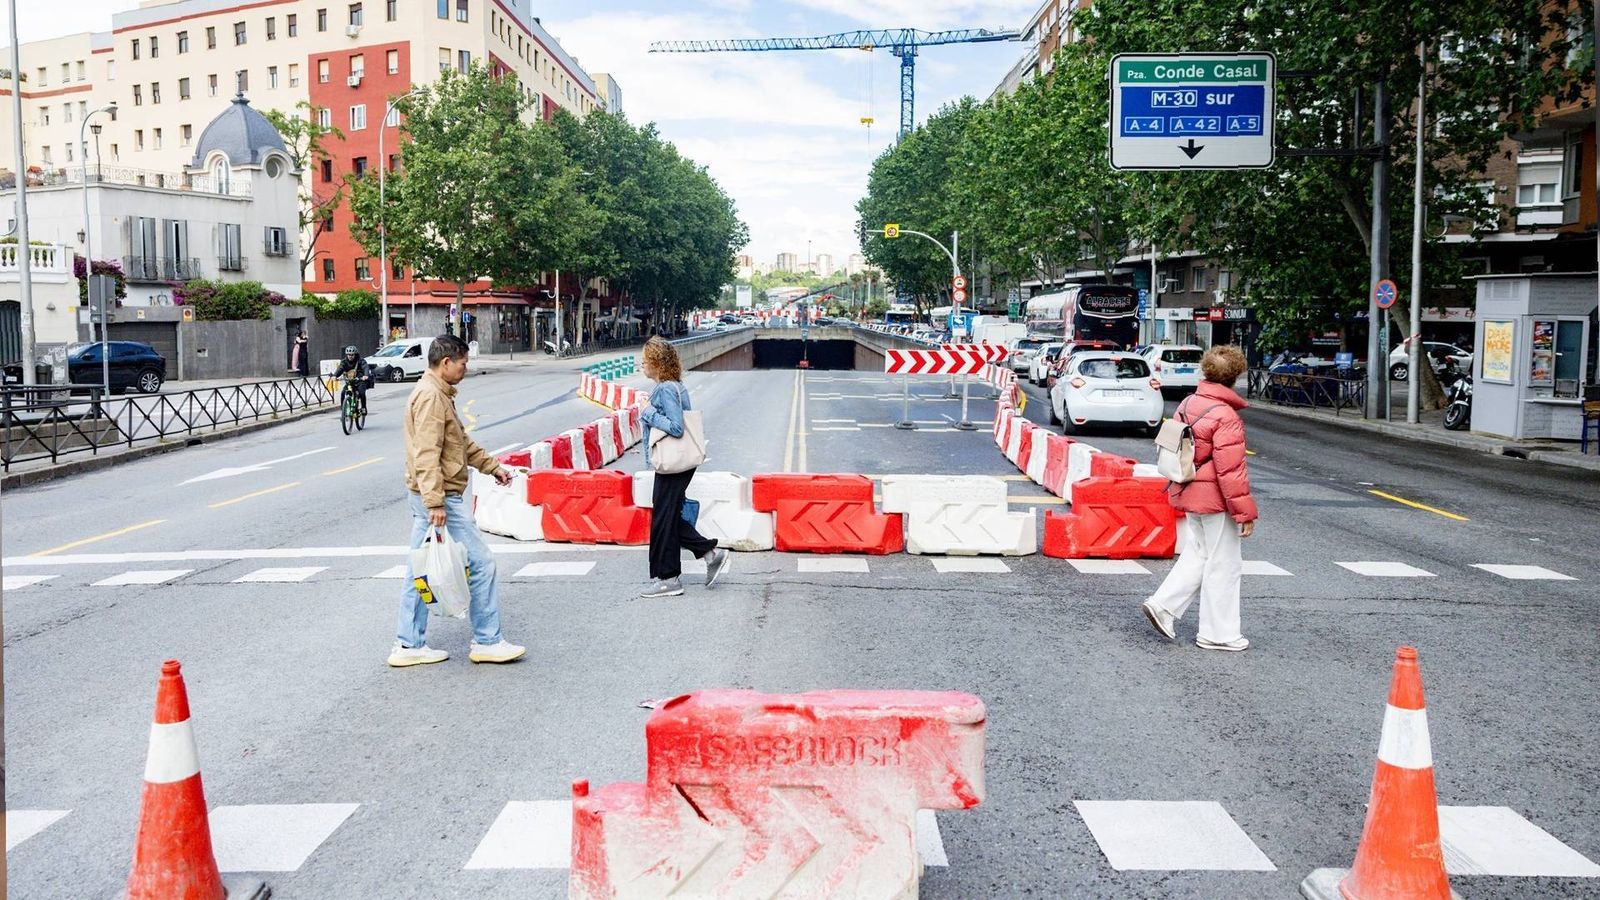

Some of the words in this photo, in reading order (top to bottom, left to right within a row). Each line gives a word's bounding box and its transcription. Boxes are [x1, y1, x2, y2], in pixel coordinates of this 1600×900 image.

[1127, 70, 1147, 79] Pza.
[1154, 65, 1205, 79] Conde
[1213, 64, 1258, 78] Casal
[1153, 92, 1196, 106] M-30
[1205, 93, 1235, 105] sur
